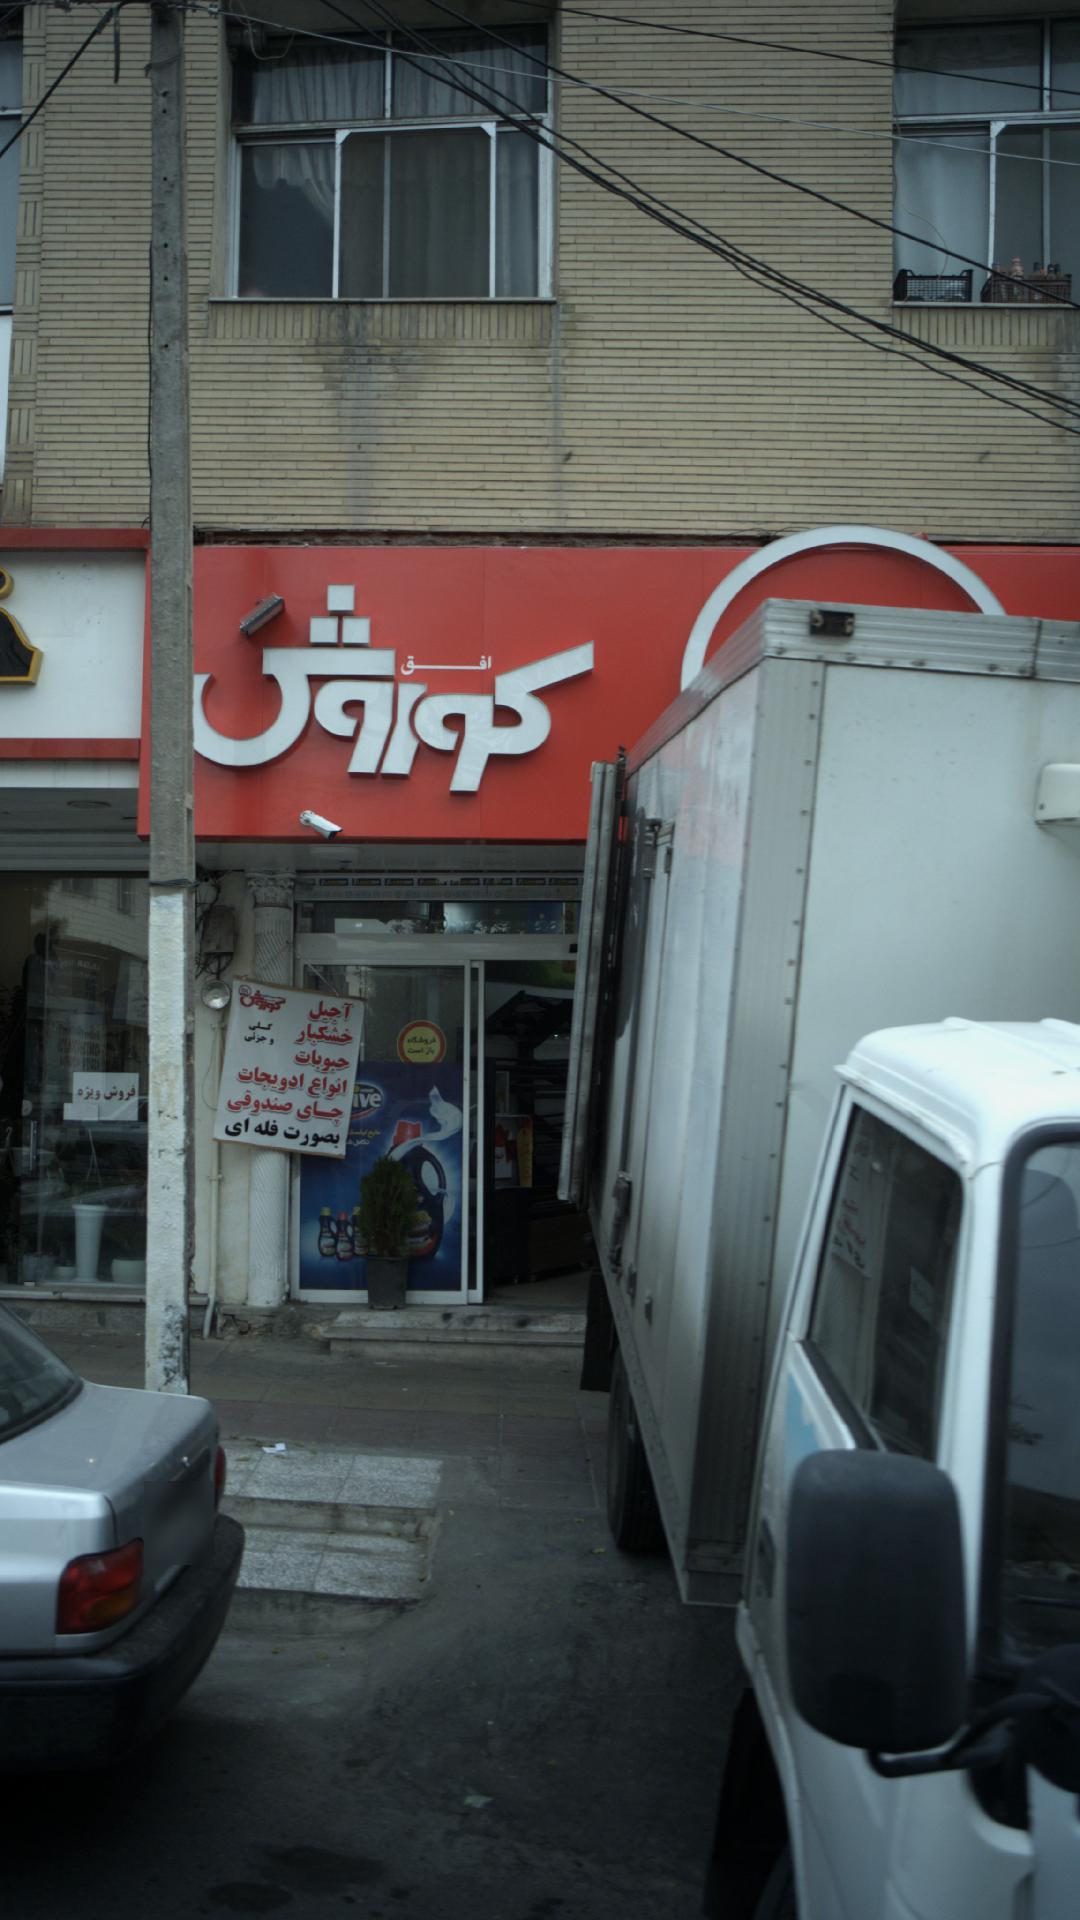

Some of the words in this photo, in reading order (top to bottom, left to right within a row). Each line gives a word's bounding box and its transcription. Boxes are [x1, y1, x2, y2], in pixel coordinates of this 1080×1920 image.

[400, 656, 492, 675] افق
[194, 583, 594, 792] کوروش
[309, 1001, 353, 1022] آجیل
[249, 1022, 272, 1031] کلی
[295, 1024, 353, 1045] خشکبار
[295, 1049, 349, 1073] حبوبات
[238, 1067, 304, 1092] ادویجات
[308, 1075, 347, 1099] انواع
[78, 1086, 100, 1100] ویژه
[104, 1084, 136, 1100] فروش
[227, 1090, 293, 1114] صندوقی
[296, 1101, 343, 1126] چای
[225, 1118, 250, 1136] ای
[254, 1119, 278, 1135] فله
[283, 1126, 339, 1147] بصورت
